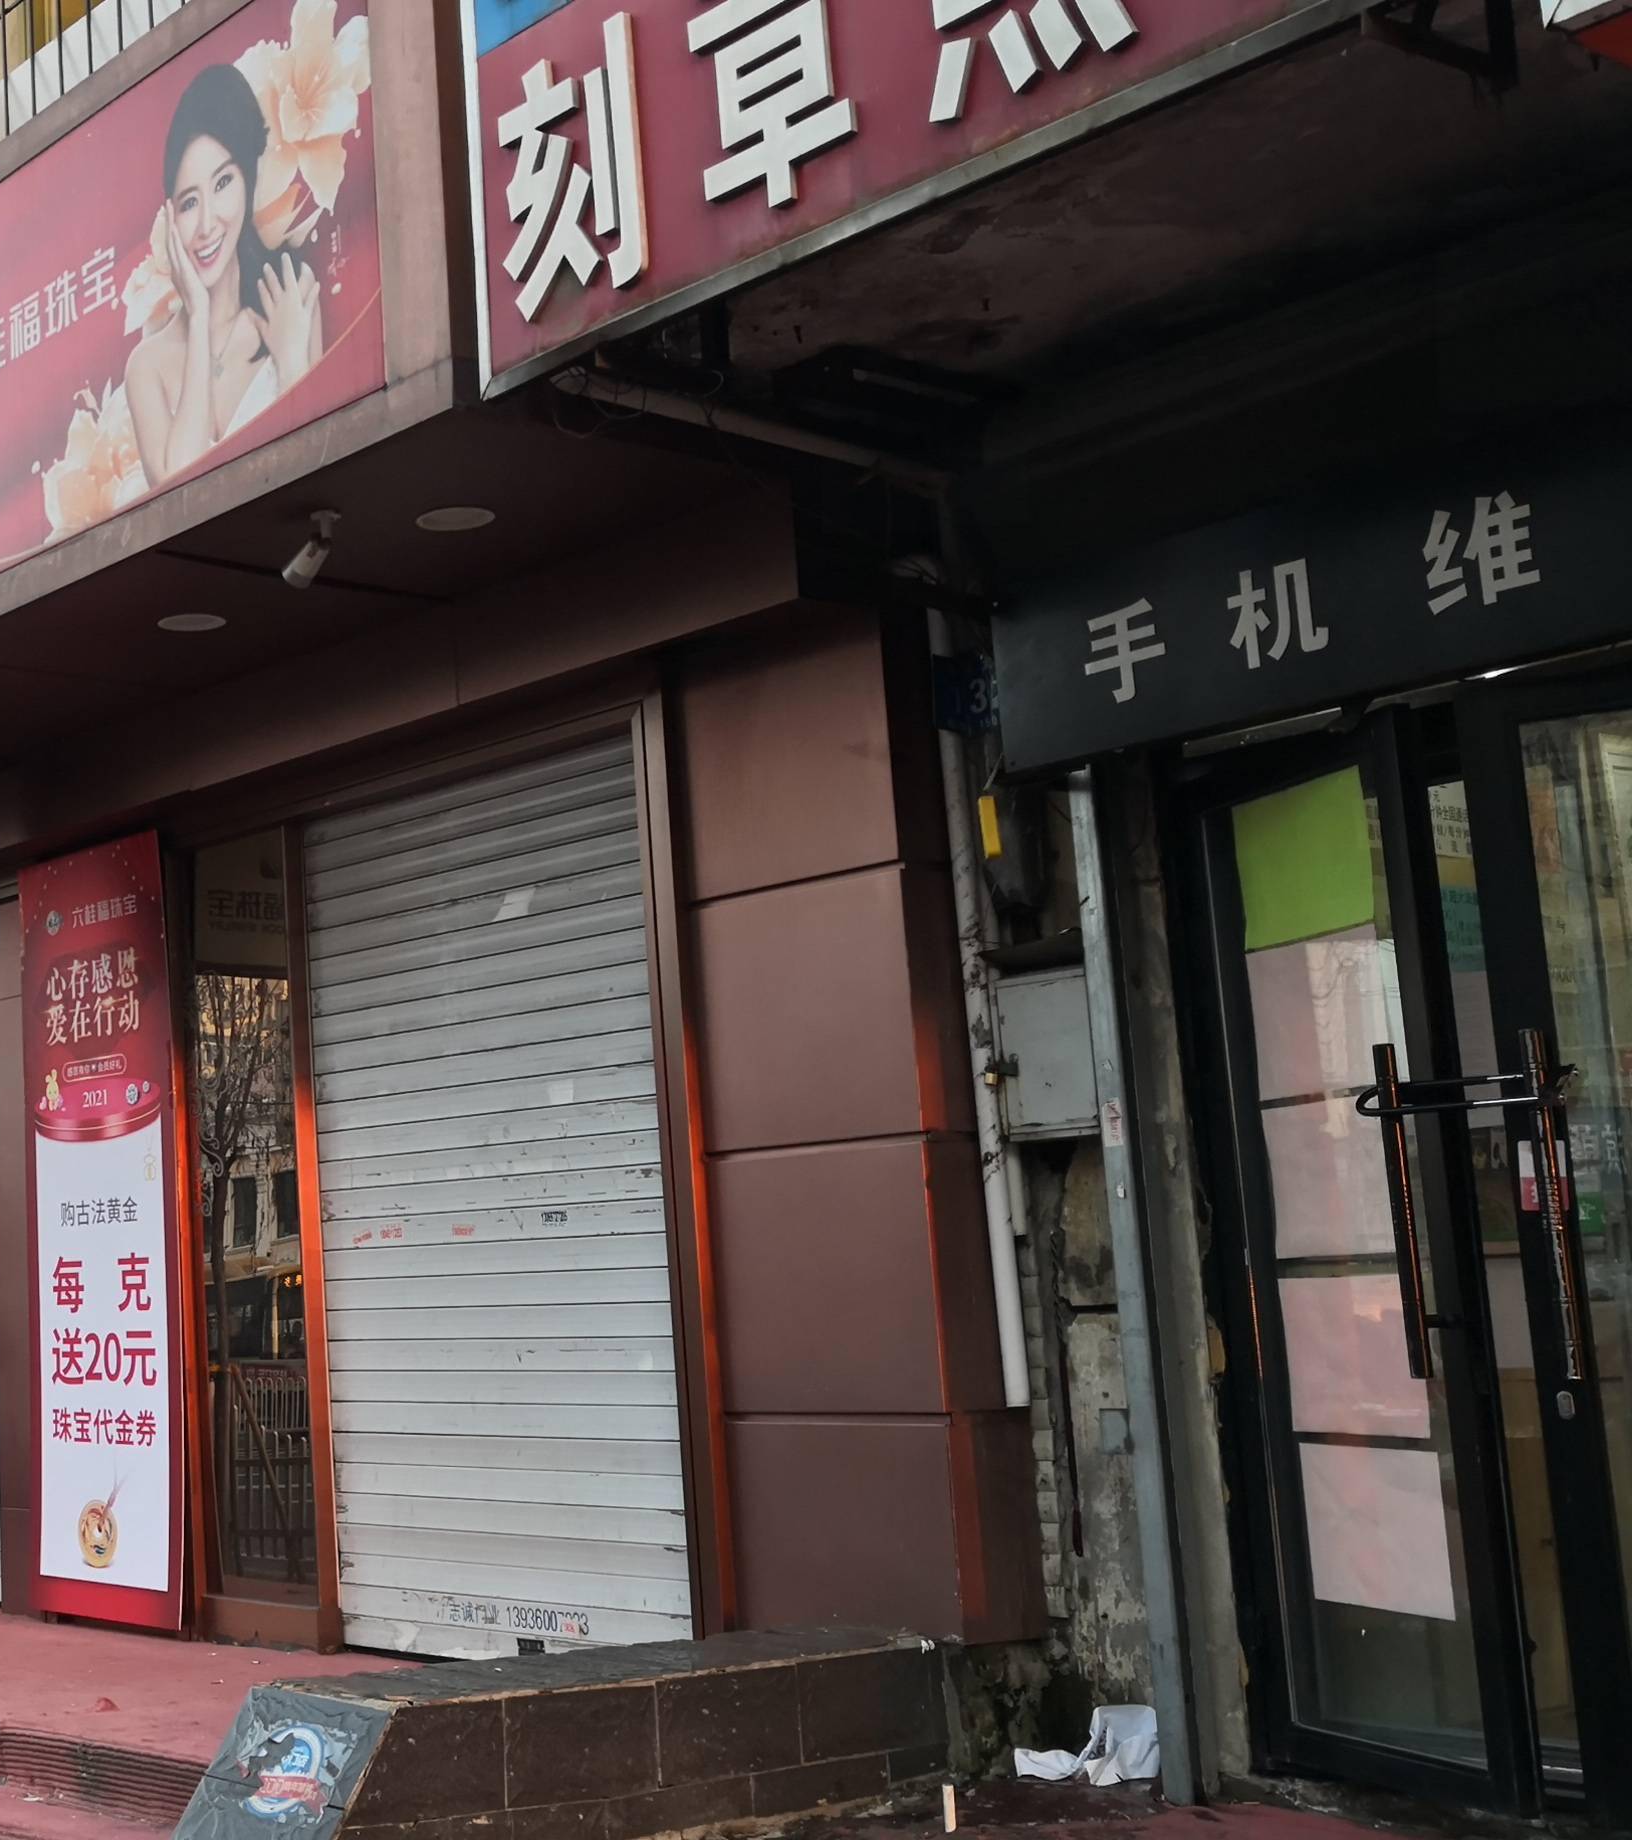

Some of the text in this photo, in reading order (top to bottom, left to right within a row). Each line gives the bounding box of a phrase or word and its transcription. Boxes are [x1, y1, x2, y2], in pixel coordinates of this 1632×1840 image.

[497, 0, 1140, 322] 刻章
[1083, 490, 1542, 704] 手机维
[72, 893, 137, 929] 六桂福珠宝
[46, 946, 139, 1003] 心存感恩
[46, 990, 140, 1048] 爱在行动
[82, 1089, 108, 1108] 2021
[60, 1196, 138, 1228] 购古法黄金
[52, 1251, 152, 1315] 每克
[51, 1326, 158, 1387] 送20元
[52, 1407, 157, 1448] 珠宝代金券
